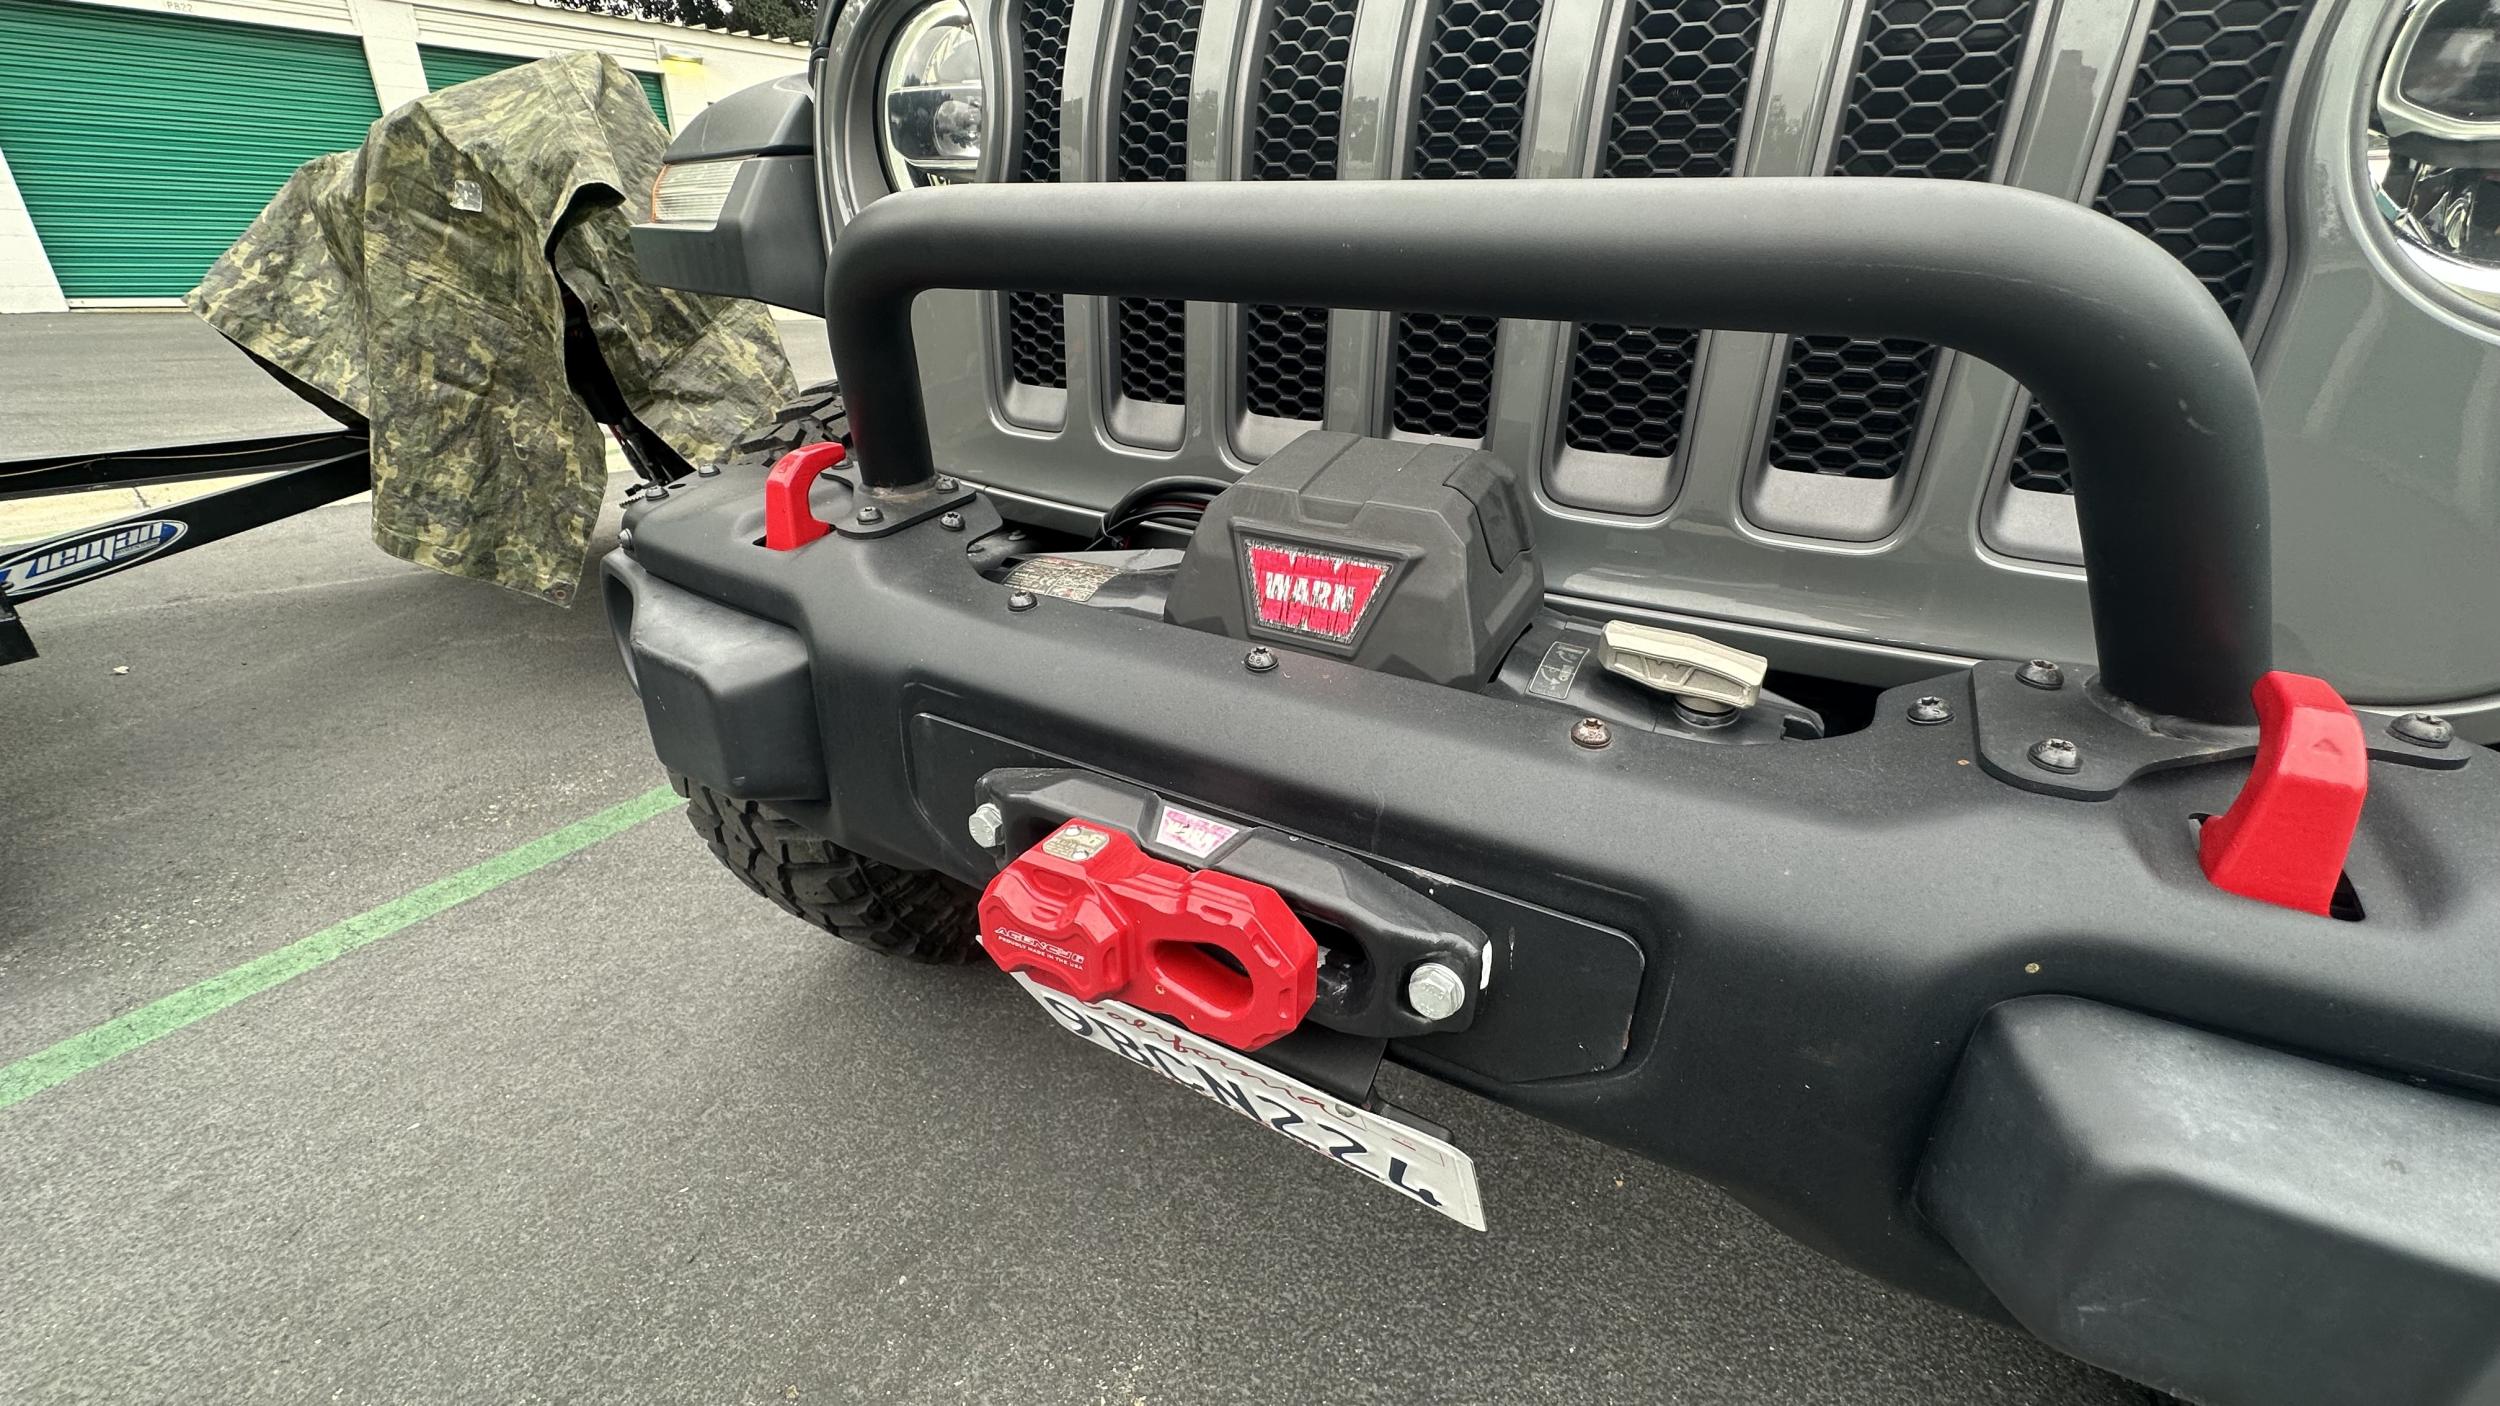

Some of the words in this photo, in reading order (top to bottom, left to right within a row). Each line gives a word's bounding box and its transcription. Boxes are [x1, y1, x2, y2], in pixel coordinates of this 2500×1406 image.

[1265, 571, 1357, 614] WARN
[995, 927, 1071, 959] AGENCY
[1071, 953, 1085, 964] 6
[998, 935, 1027, 949] PROUDLY
[1027, 945, 1046, 957] MADE
[1055, 956, 1068, 965] THE
[1069, 962, 1084, 971] USA
[1043, 993, 1444, 1208] 9BCN224
